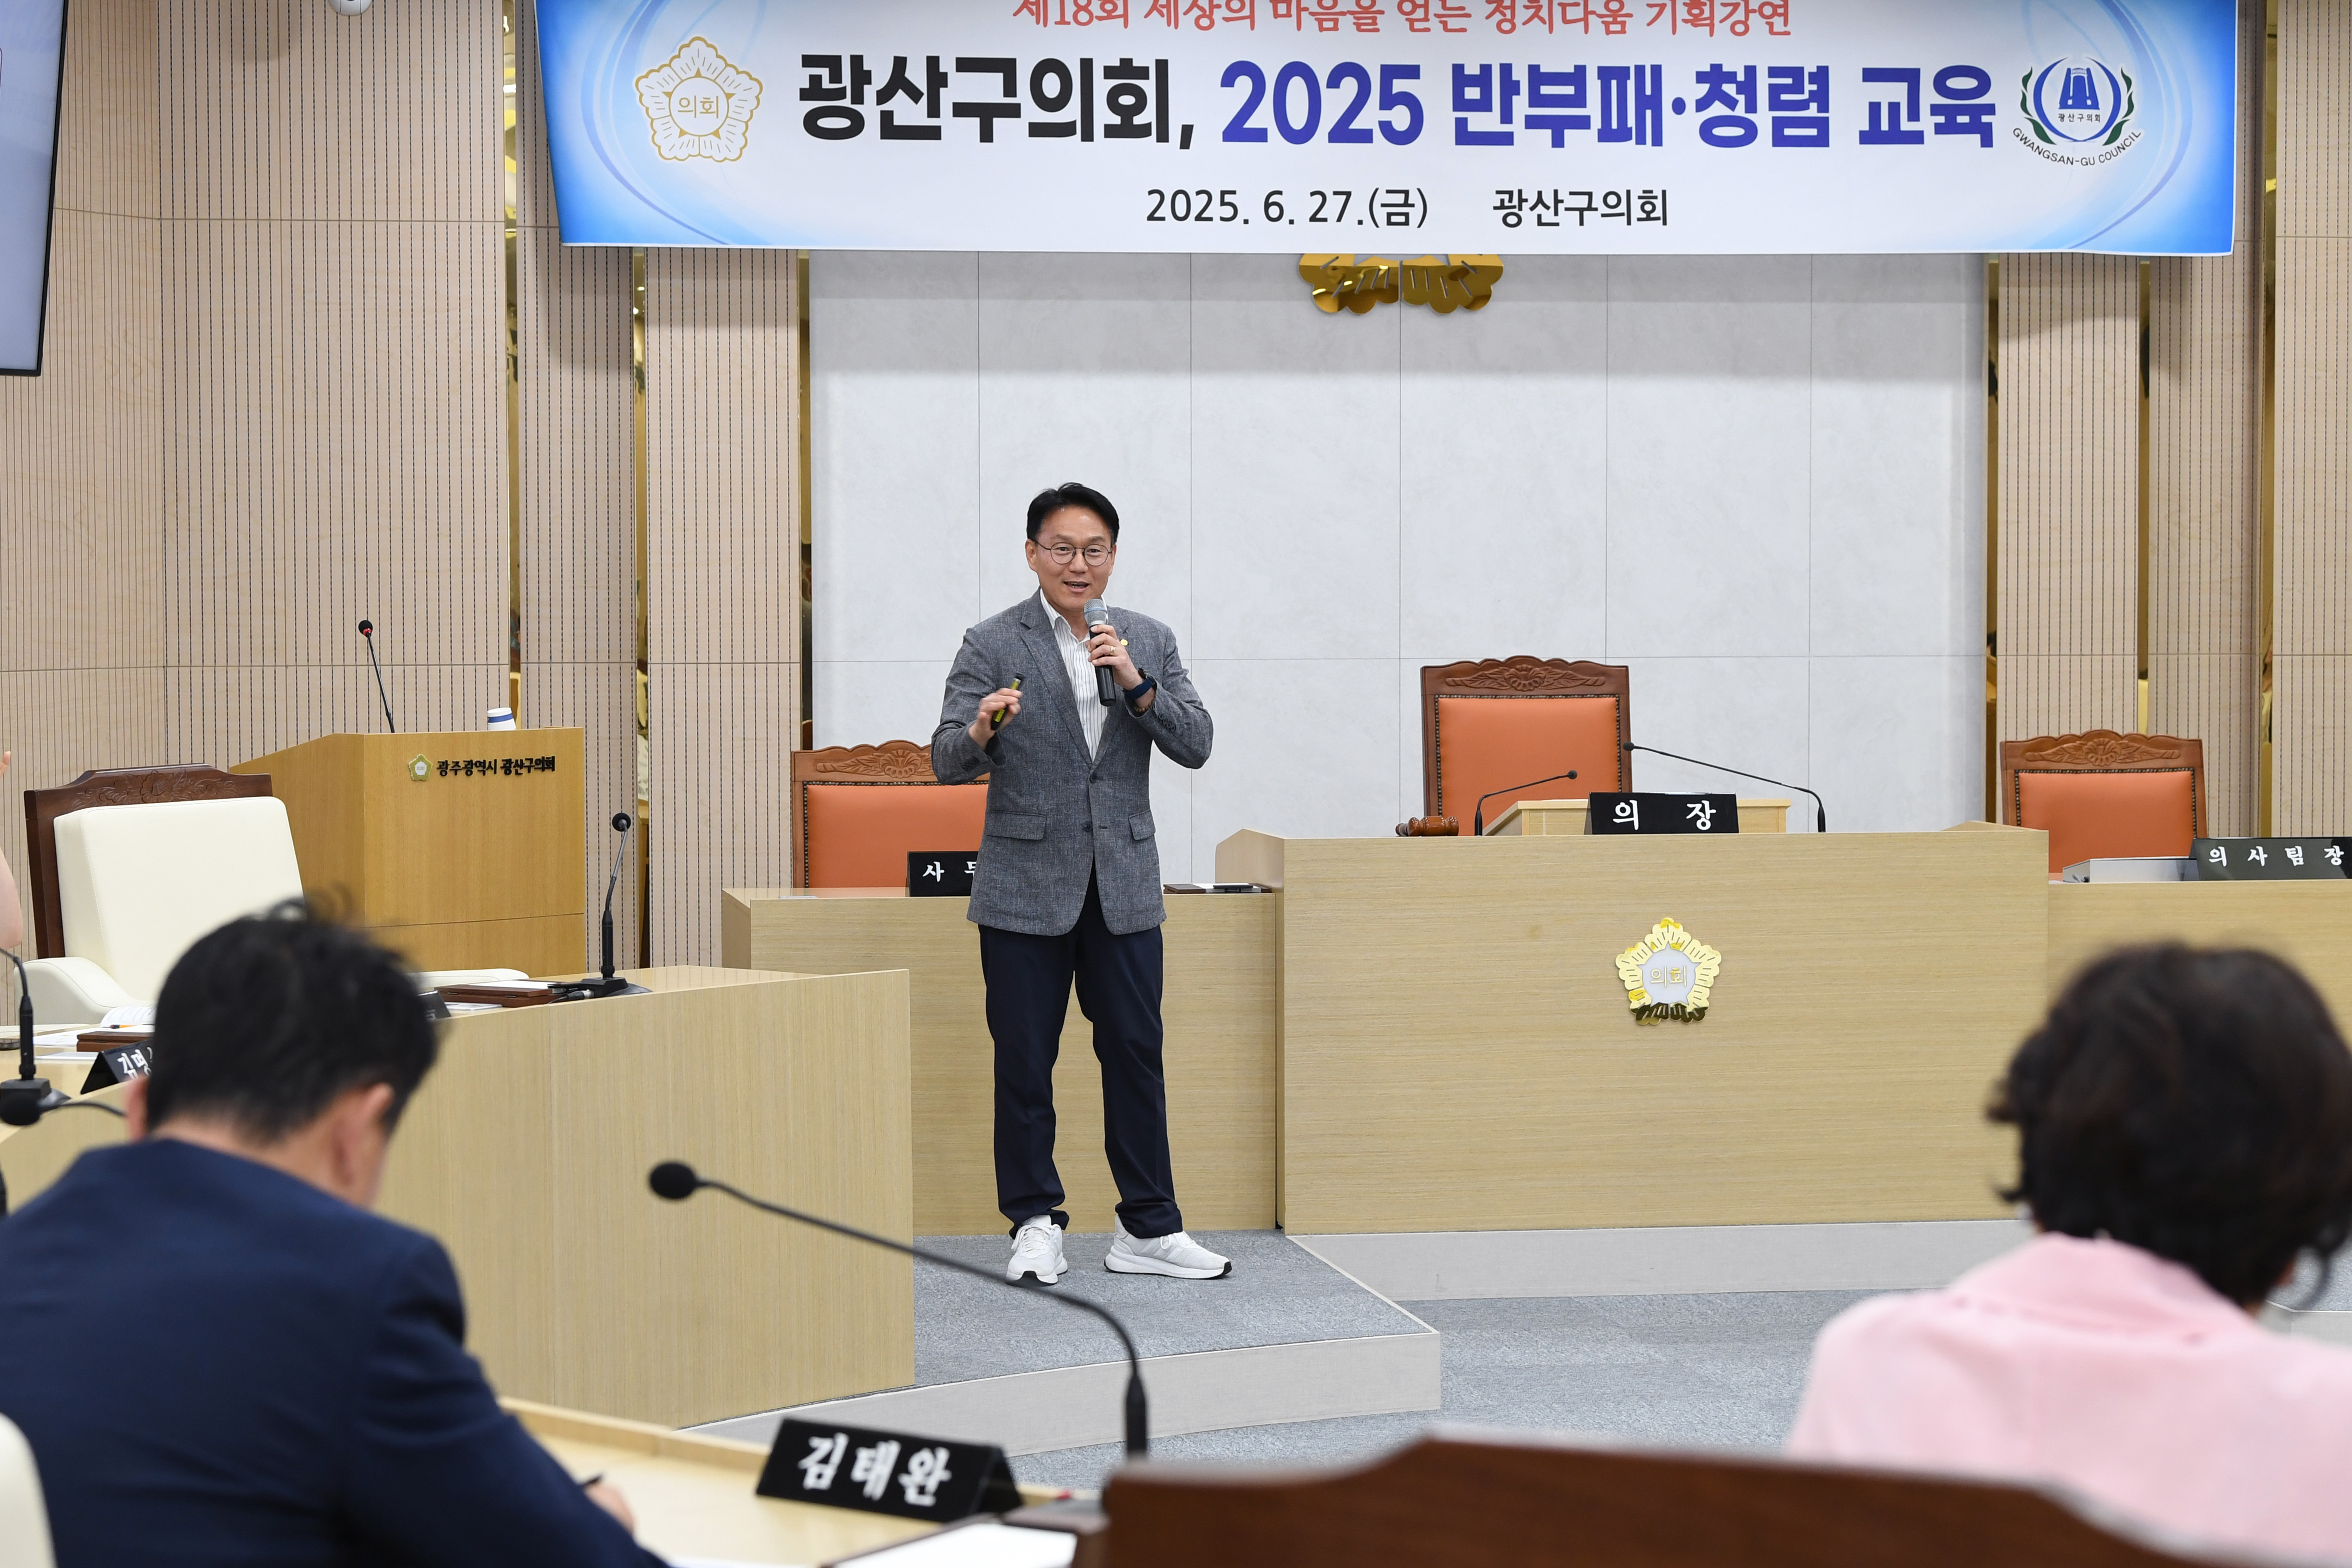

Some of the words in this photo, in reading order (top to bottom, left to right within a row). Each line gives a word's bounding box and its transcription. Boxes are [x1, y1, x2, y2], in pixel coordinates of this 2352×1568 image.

[1014, 0, 1129, 29] 제18회
[1144, 0, 1255, 31] 세상의
[1270, 0, 1385, 33] 마음을
[1397, 0, 1472, 33] 얻는
[1486, 0, 1633, 36] 정치다움
[1647, 0, 1791, 37] 기획강연
[677, 95, 719, 119] 의회
[799, 54, 1194, 150] 광산구의회,
[1220, 60, 1424, 146] 2025
[1859, 65, 1996, 148] 교육
[2058, 113, 2101, 123] 광산구의회
[2013, 127, 2095, 166] GWANGSAN-GU
[2098, 131, 2142, 163] COUNCIL
[1493, 188, 1667, 228] 광산구의회
[436, 759, 497, 776] 광주광역시
[500, 755, 556, 775] 광산구의회
[1650, 966, 1687, 987] 의회
[798, 1432, 952, 1507] 김태완
